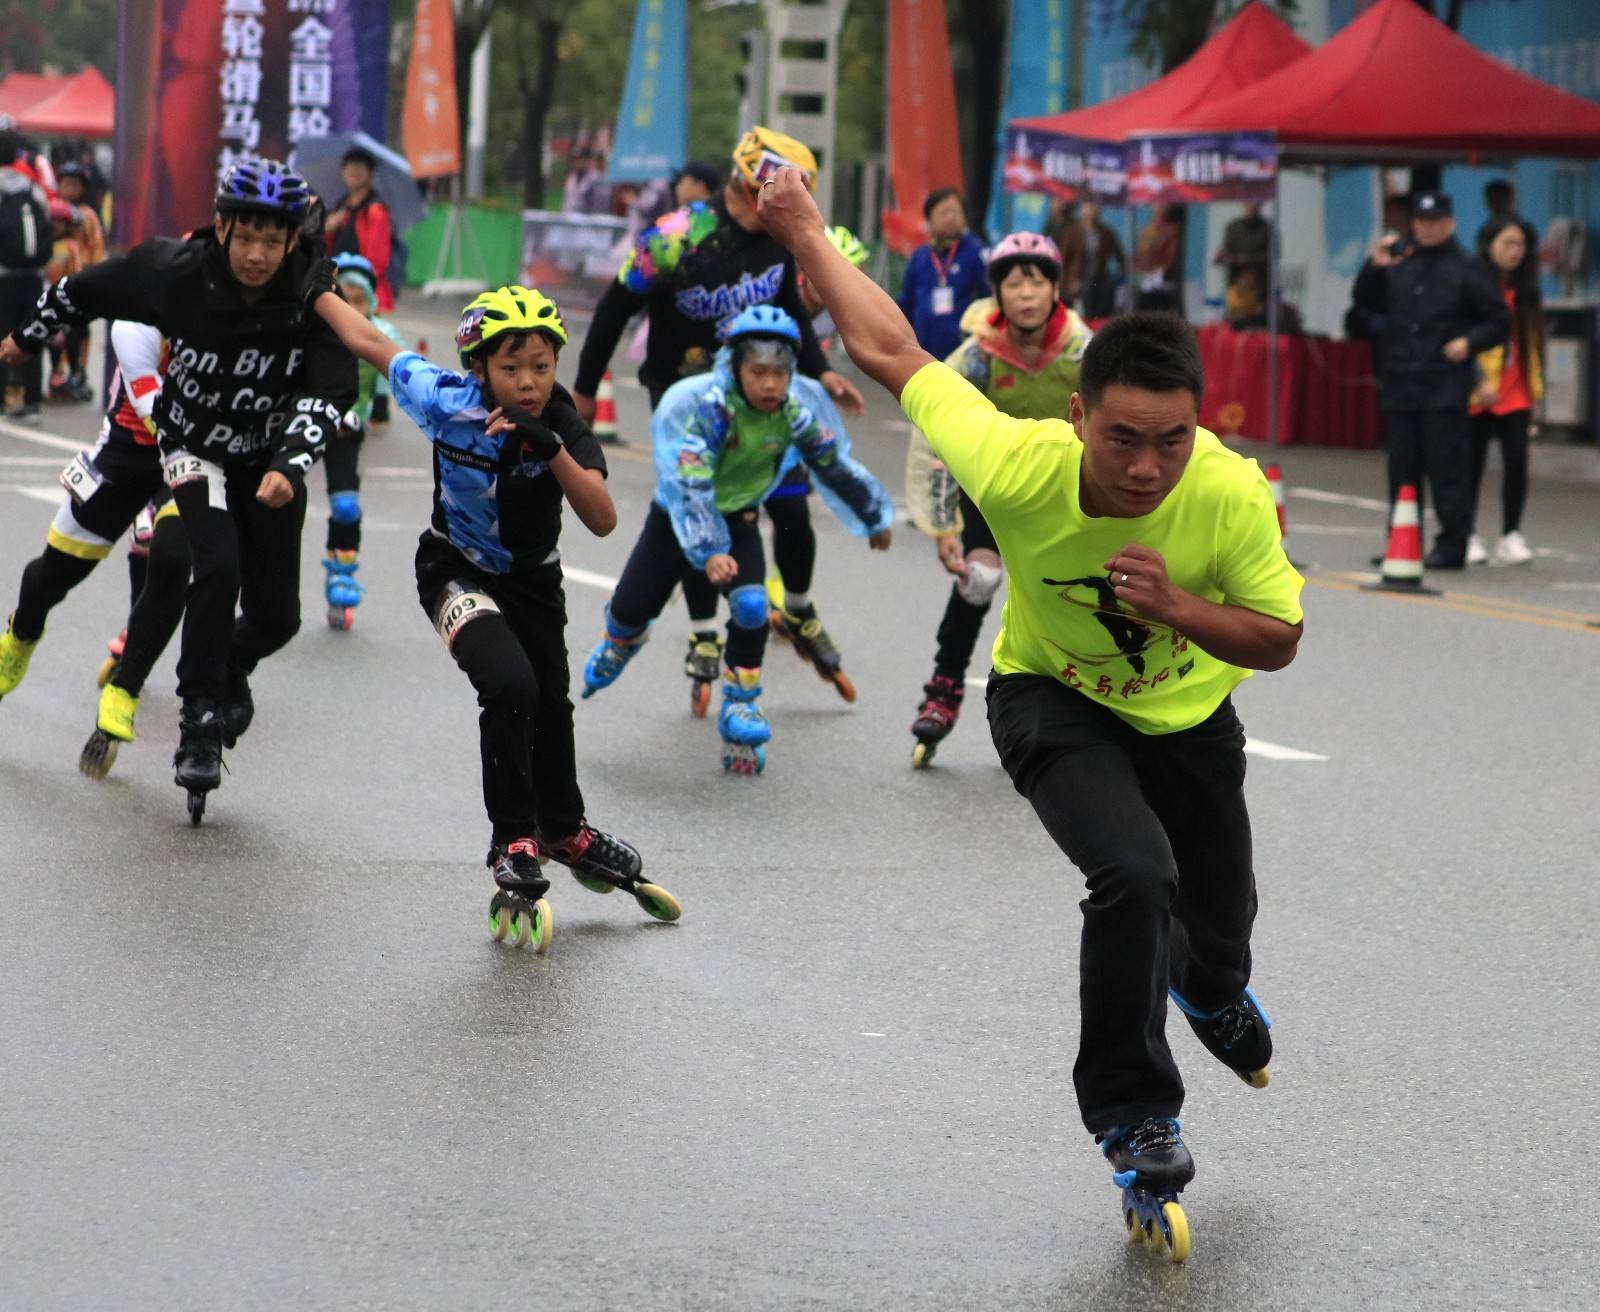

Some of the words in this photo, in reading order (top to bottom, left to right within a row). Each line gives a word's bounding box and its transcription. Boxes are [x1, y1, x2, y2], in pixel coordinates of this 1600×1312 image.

[287, 0, 334, 143] 全国轮
[674, 262, 785, 320] SKATING
[232, 348, 276, 379] By
[168, 460, 202, 481] H12
[443, 597, 477, 636] H09
